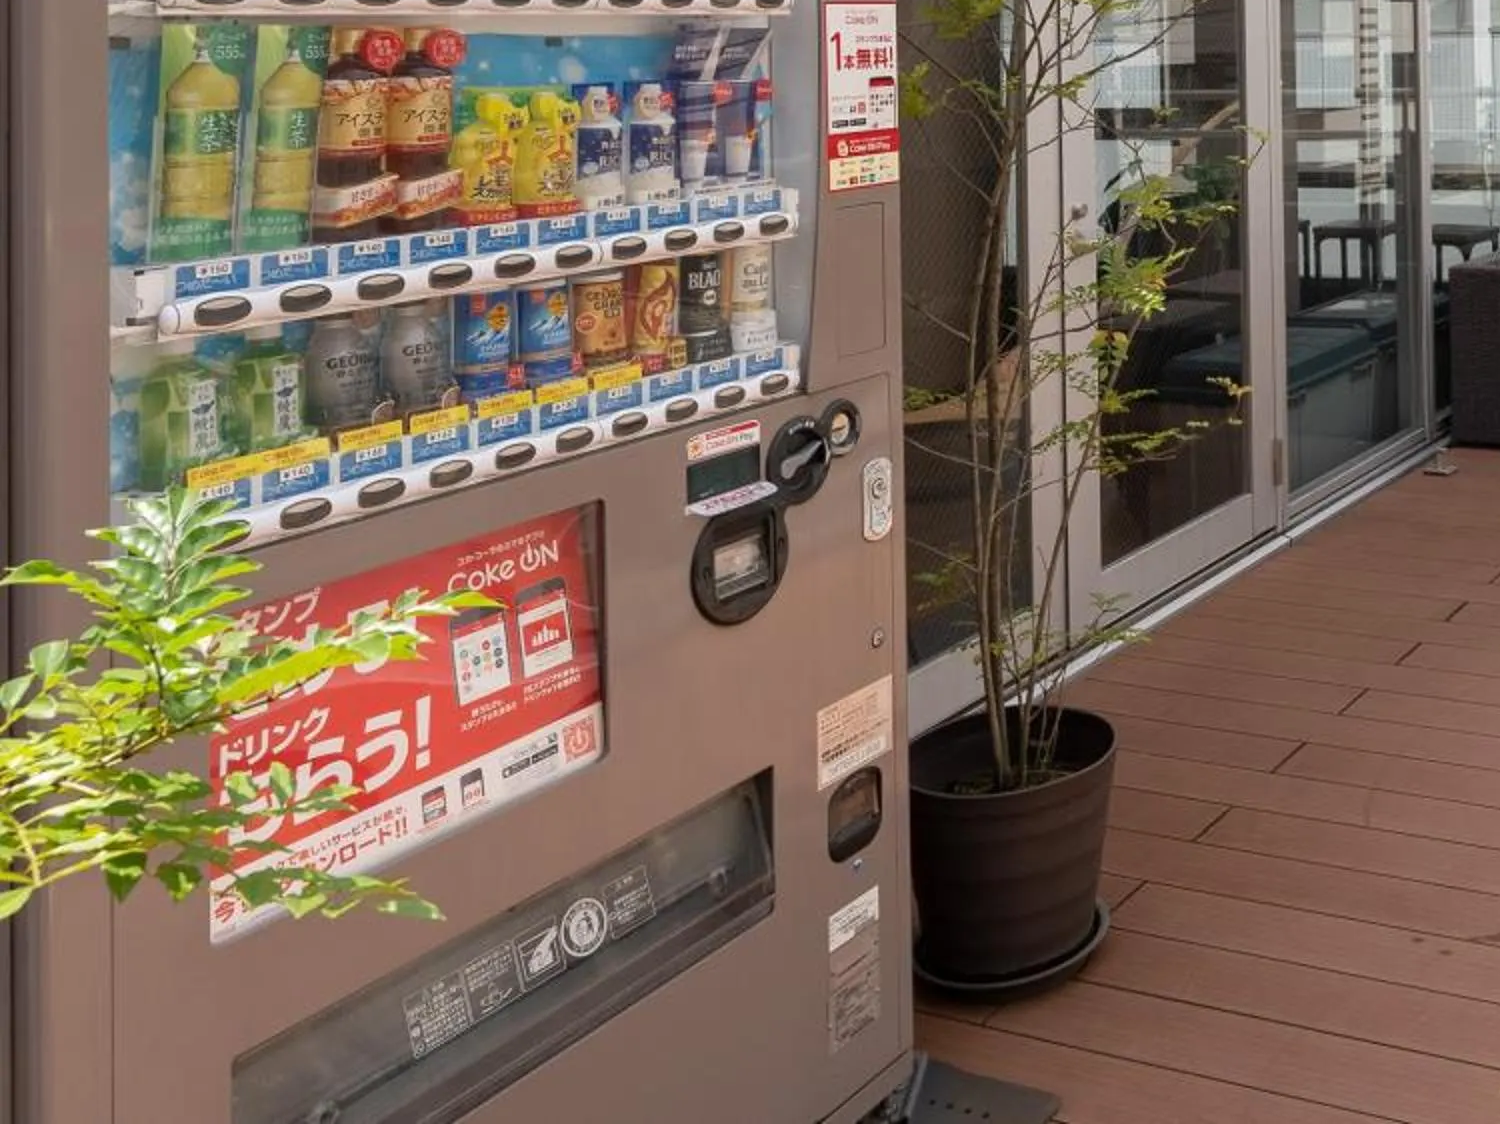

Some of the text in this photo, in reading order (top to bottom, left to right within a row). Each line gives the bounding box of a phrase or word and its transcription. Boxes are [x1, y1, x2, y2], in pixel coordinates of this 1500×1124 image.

[448, 559, 517, 596] Coke
[520, 539, 560, 572] ON
[219, 707, 331, 777] ドリンク
